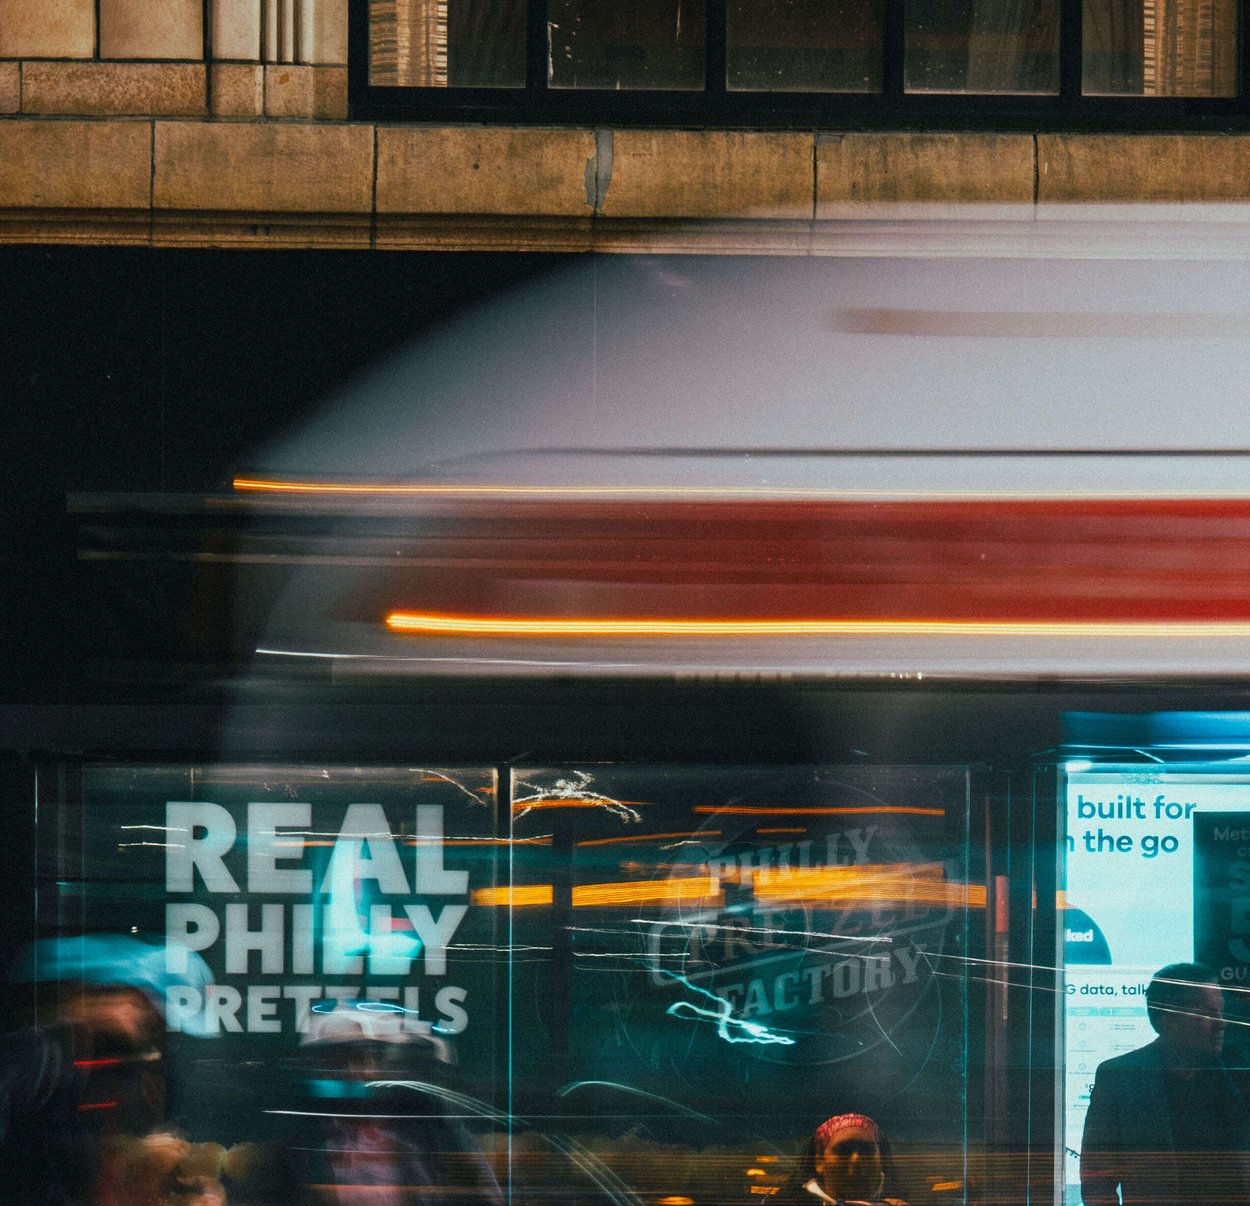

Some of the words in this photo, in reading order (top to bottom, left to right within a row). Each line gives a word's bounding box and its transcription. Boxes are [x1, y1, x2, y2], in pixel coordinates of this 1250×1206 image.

[1077, 795, 1146, 819] built
[1153, 795, 1197, 819] for
[166, 801, 469, 895] REAL
[707, 825, 879, 894] PHILLY
[1083, 829, 1134, 853] the
[1141, 835, 1180, 858] go
[166, 903, 469, 976] PHILLY
[166, 985, 469, 1035] PRETZELS
[717, 943, 927, 1019] FACTORY
[1080, 984, 1118, 996] data,
